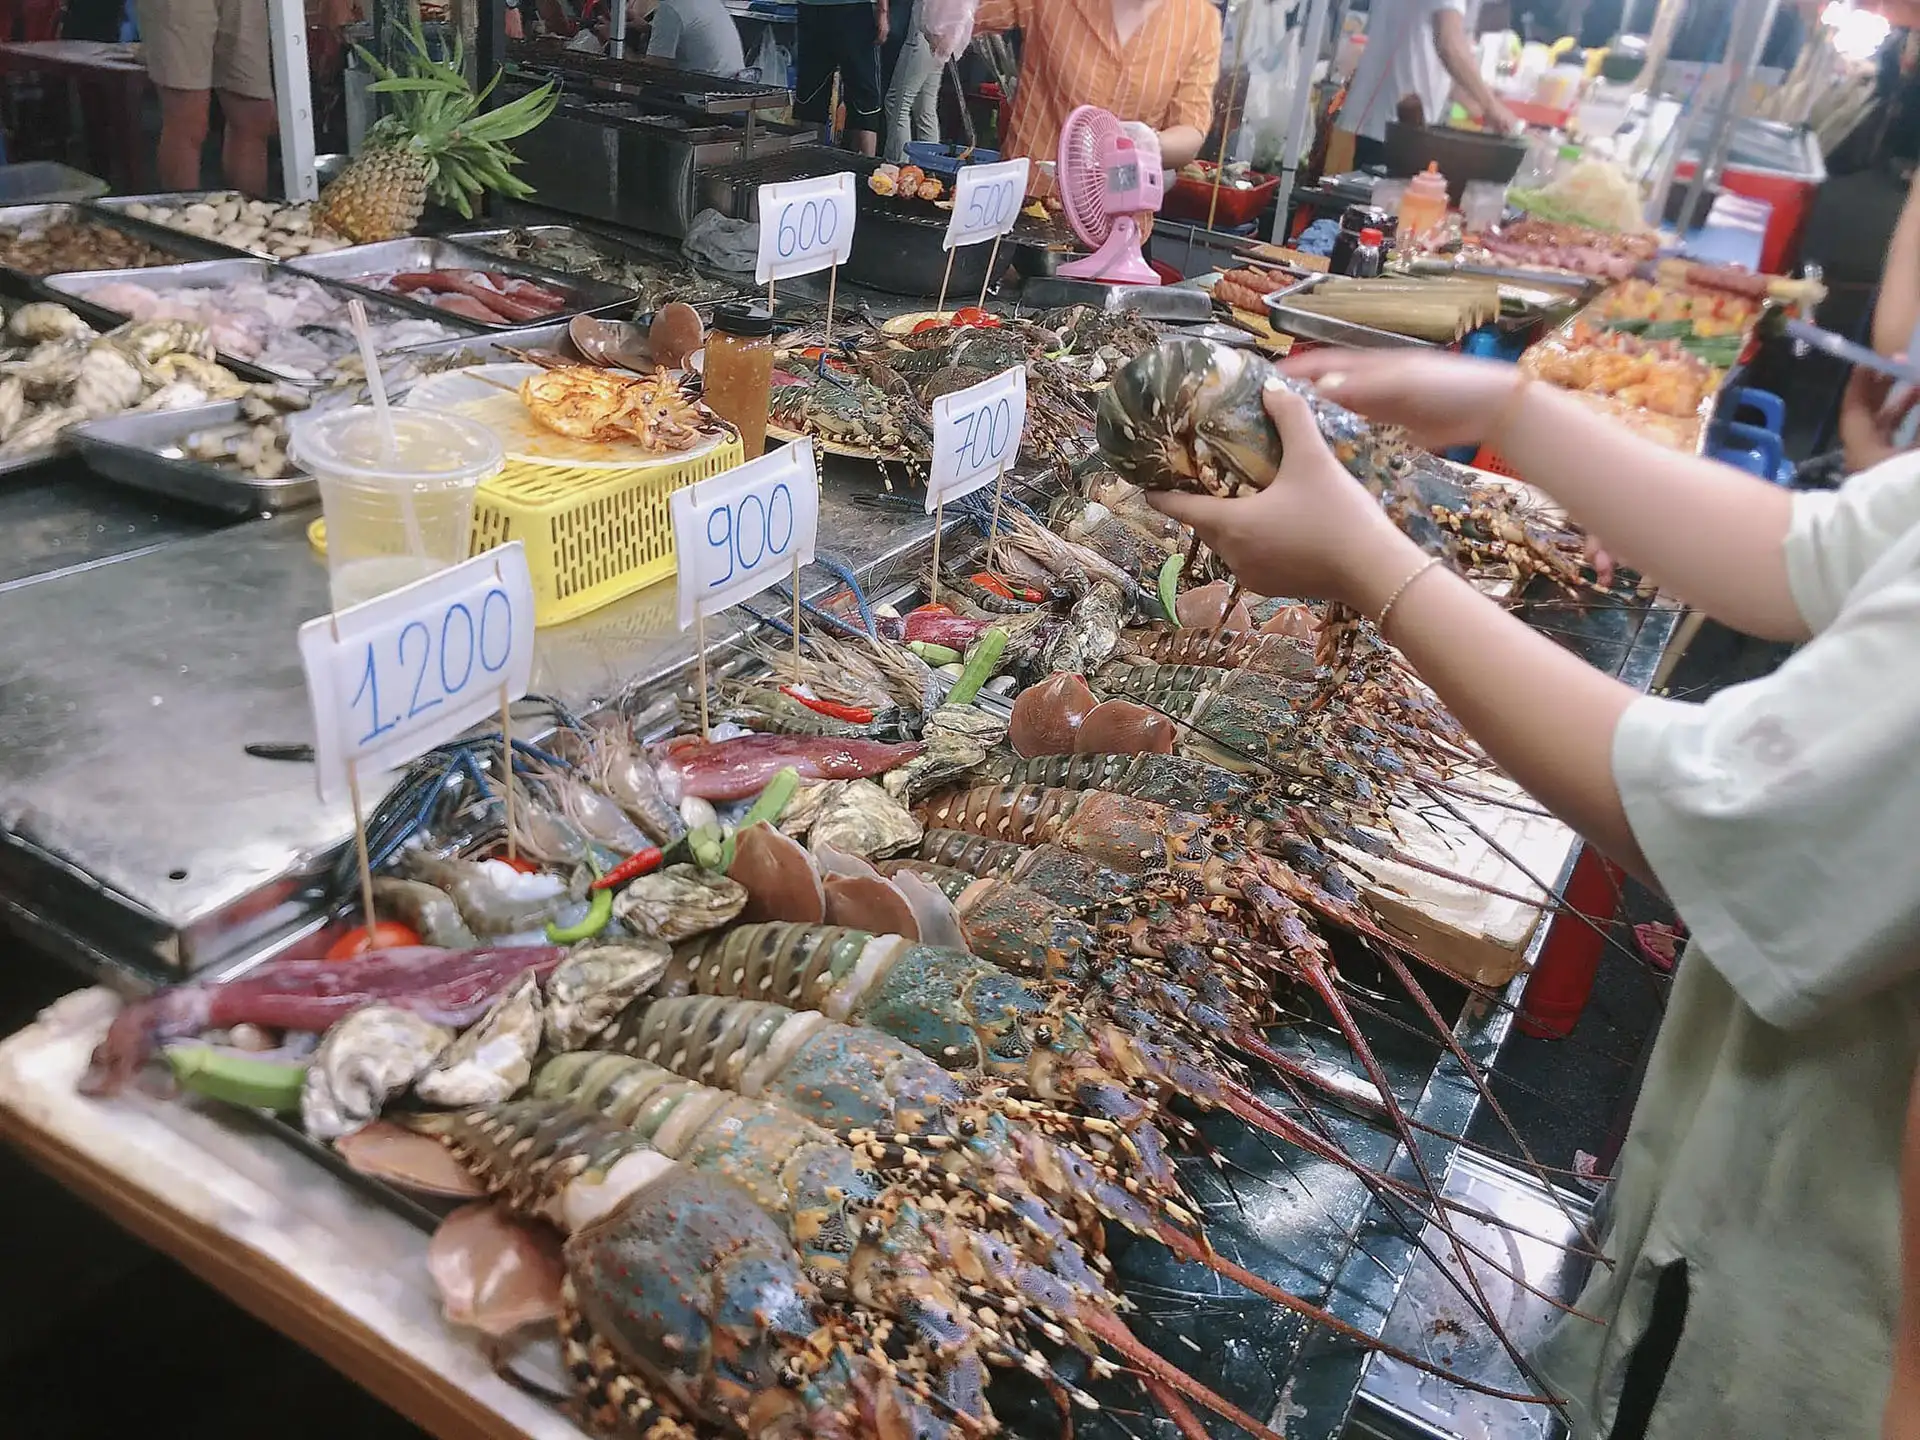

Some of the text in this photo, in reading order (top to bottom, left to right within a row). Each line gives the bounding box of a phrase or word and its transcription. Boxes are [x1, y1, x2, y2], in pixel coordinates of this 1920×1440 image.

[777, 199, 838, 257] 600
[964, 180, 1014, 228] 500
[953, 398, 1010, 477] 700
[707, 482, 794, 588] 900
[352, 588, 513, 745] 1.200
